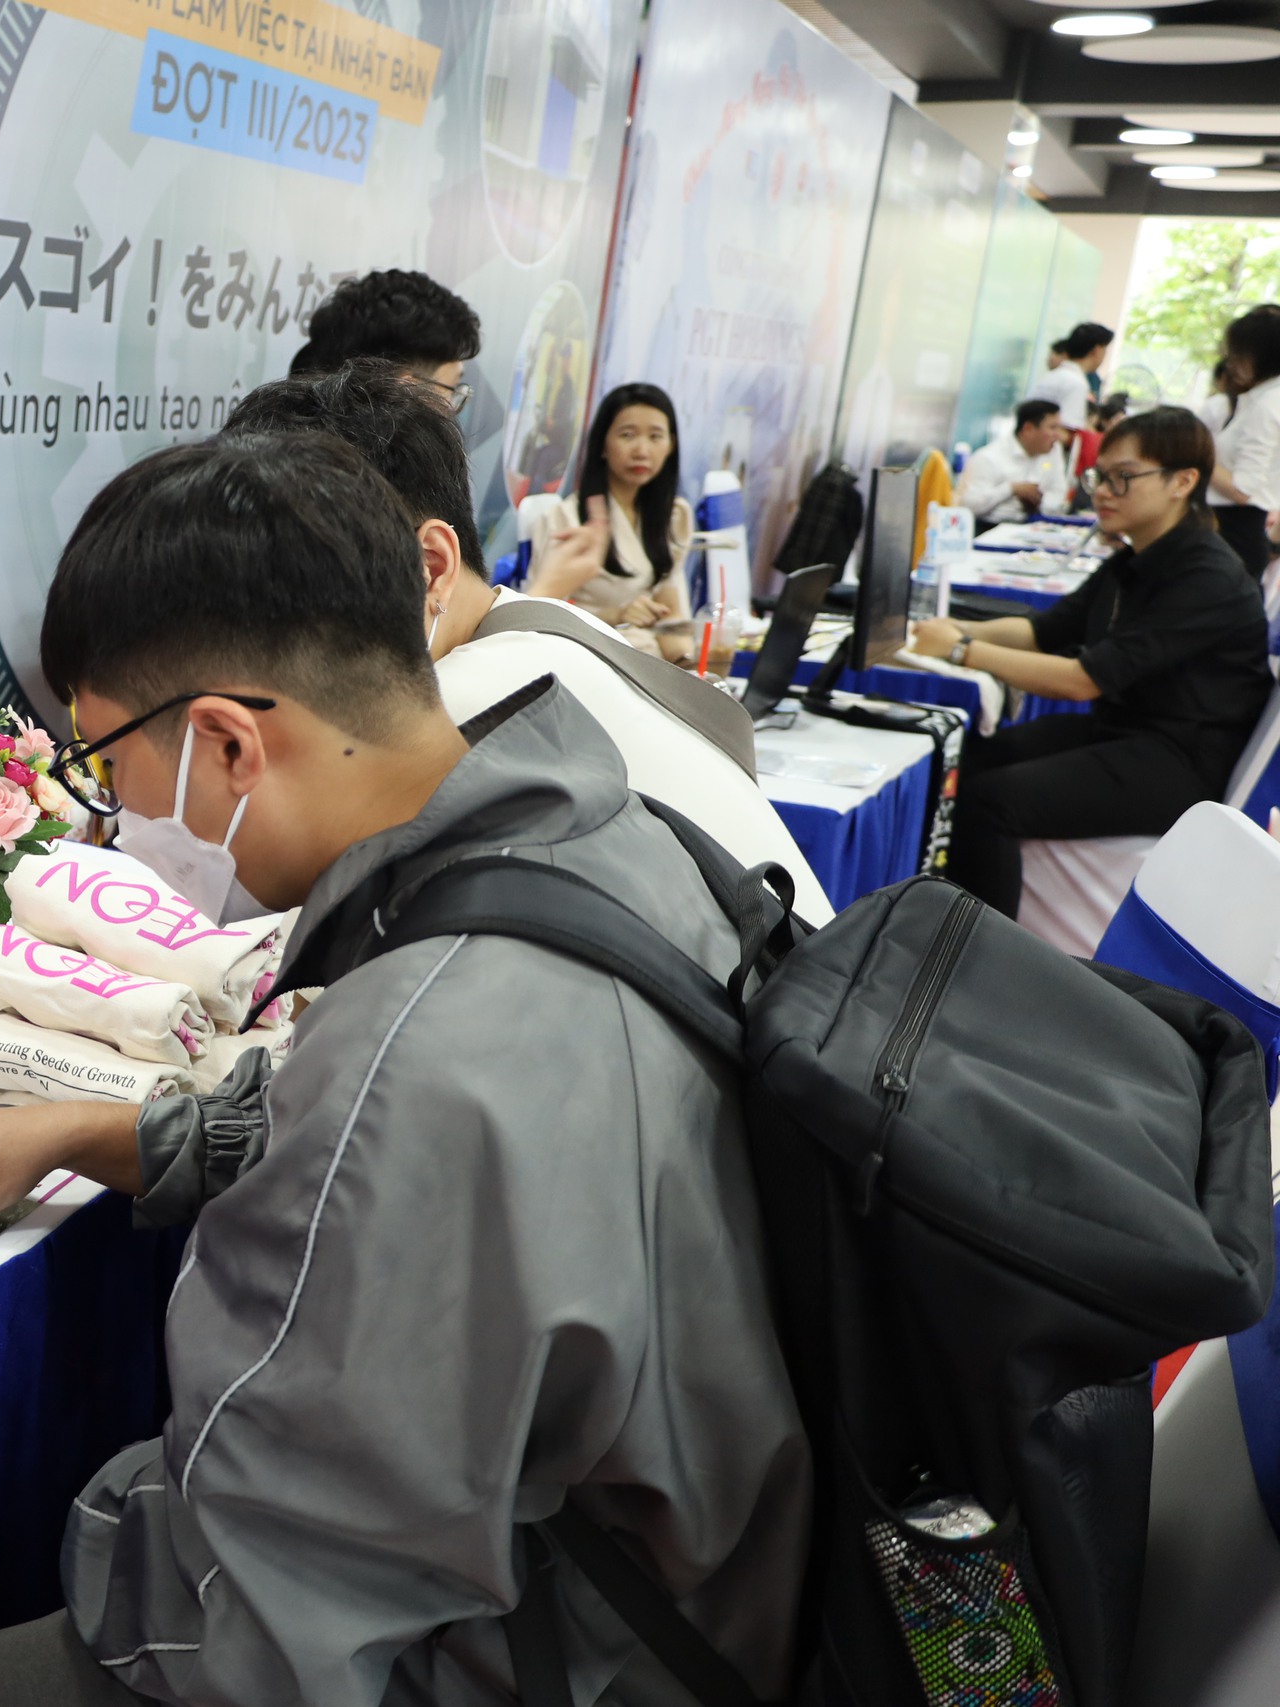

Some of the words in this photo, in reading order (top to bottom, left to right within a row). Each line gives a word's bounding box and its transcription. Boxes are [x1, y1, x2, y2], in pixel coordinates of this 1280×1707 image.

[293, 19, 327, 73] TẠI
[331, 35, 387, 91] NHẬT
[152, 50, 238, 140] ĐỢT
[247, 79, 369, 165] III/2023
[73, 381, 149, 433] nhau
[160, 386, 200, 444] tạo
[210, 380, 240, 429] nê
[0, 1066, 19, 1075] are
[32, 1049, 71, 1073] Seeds
[71, 1063, 86, 1078] of
[87, 1067, 137, 1089] Growth
